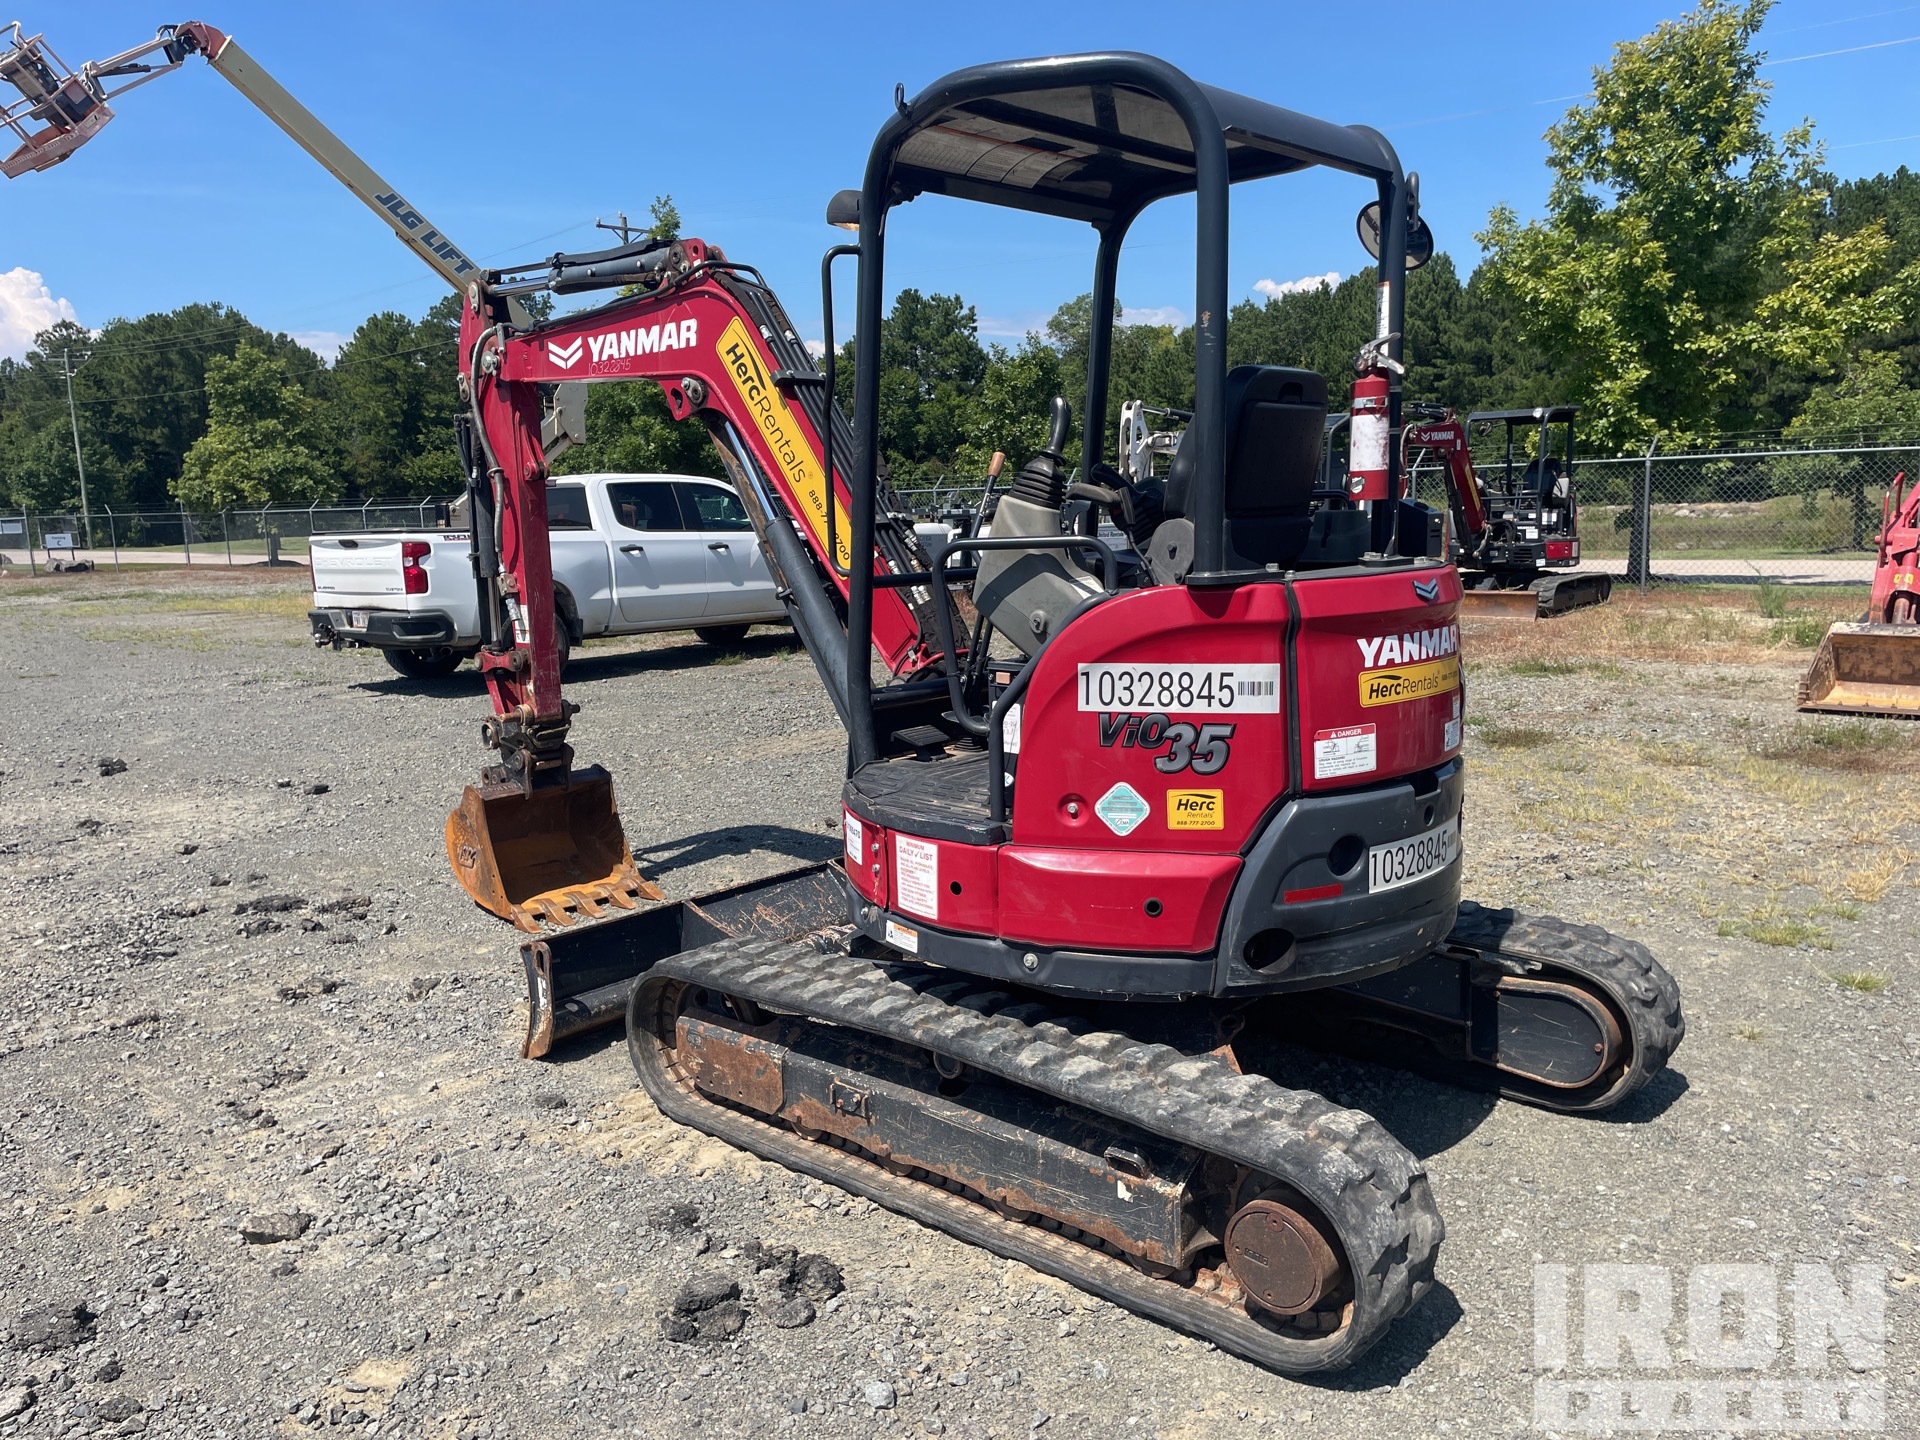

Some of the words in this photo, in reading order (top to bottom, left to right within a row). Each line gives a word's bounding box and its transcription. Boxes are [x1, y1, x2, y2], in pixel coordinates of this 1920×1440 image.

[374, 192, 425, 231] JLG
[419, 229, 475, 275] LIFT
[587, 318, 698, 362] YANMAR
[724, 341, 806, 484] HercRentals
[1430, 431, 1455, 441] YANMAR
[1356, 624, 1458, 669] YANMAR
[1080, 671, 1235, 708] 10328845
[1337, 728, 1362, 738] DANGER
[1176, 798, 1216, 811] Herc
[1187, 811, 1213, 819] Rentals
[920, 852, 934, 862] LIST
[1370, 829, 1449, 887] 10328845
